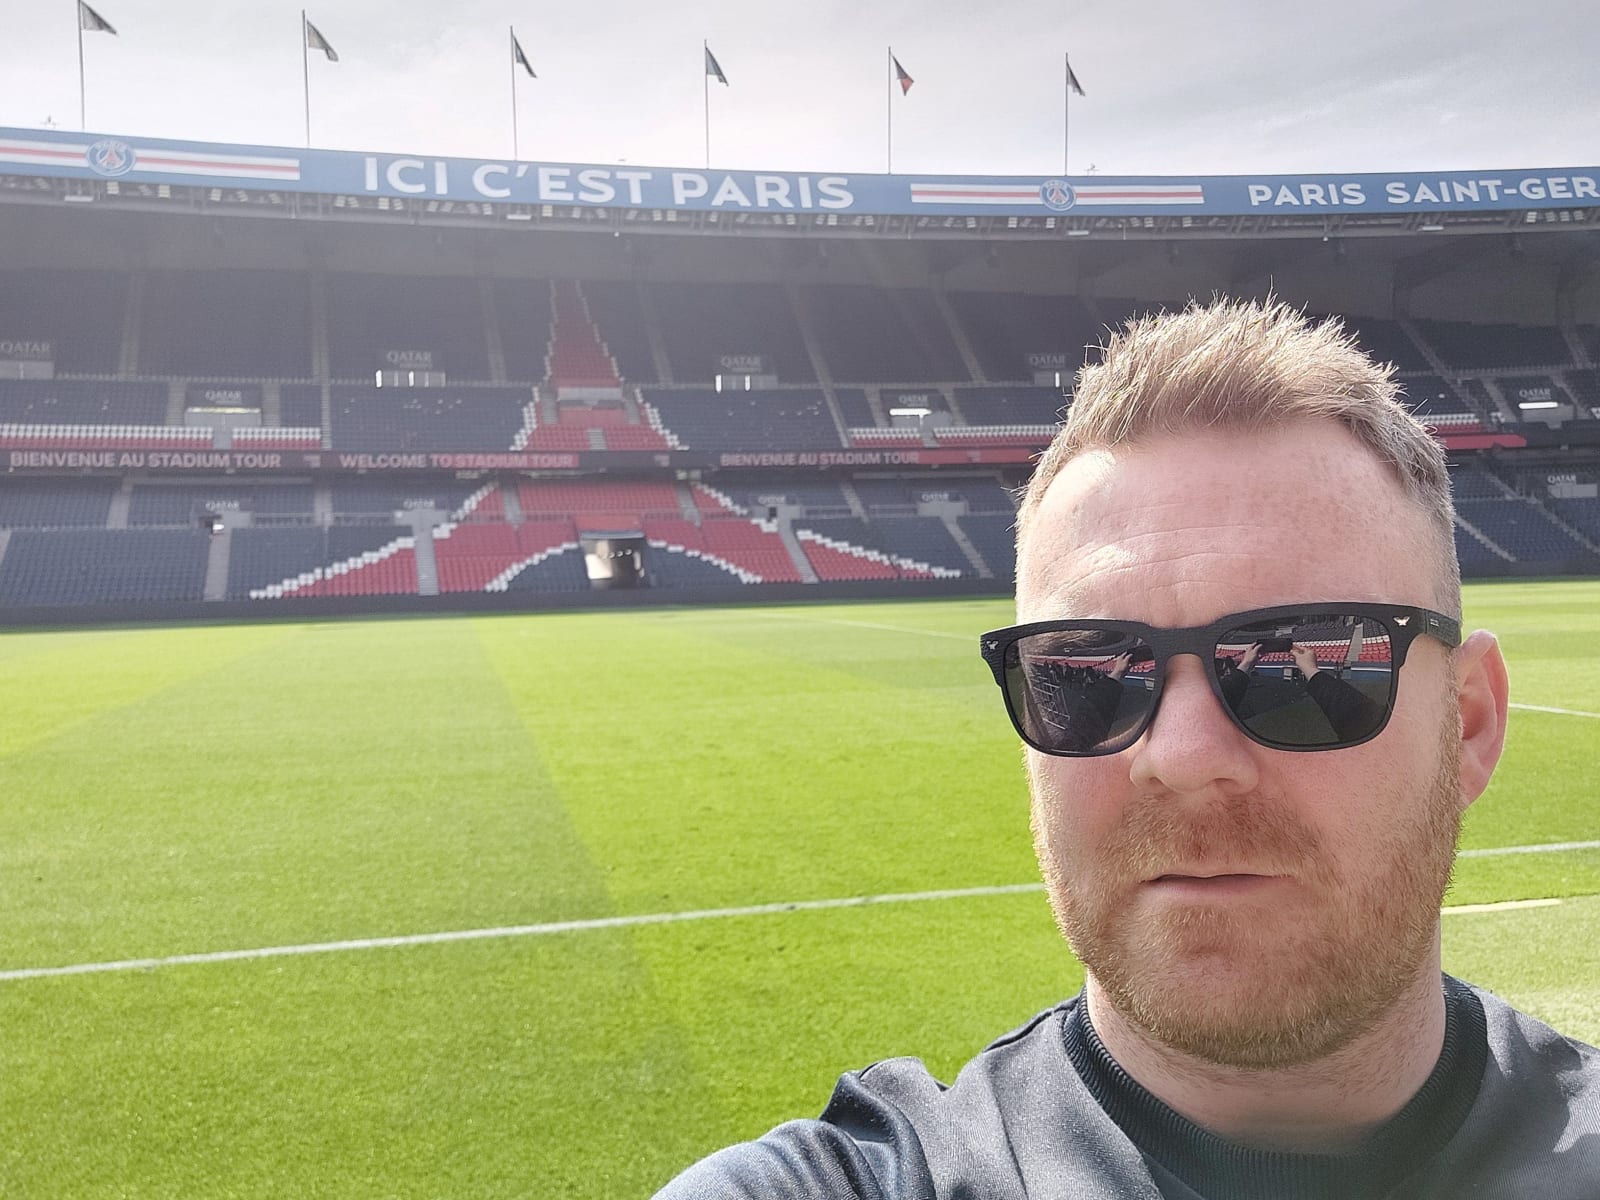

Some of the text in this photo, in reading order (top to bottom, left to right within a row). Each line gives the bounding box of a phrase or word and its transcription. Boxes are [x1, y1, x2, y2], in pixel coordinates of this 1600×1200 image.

[365, 158, 854, 209] ICI C'EST PARIS
[1249, 176, 1600, 206] PARIS SAINT-GER
[1519, 388, 1551, 397] QATAR
[10, 453, 282, 468] BIENVENUE AU STADIUM TOUR
[339, 453, 575, 468] WELCOME TO STADIUM TOUR
[721, 451, 920, 467] BIENVENUE AU STADIUM TOUR
[1547, 475, 1576, 484] QATAR
